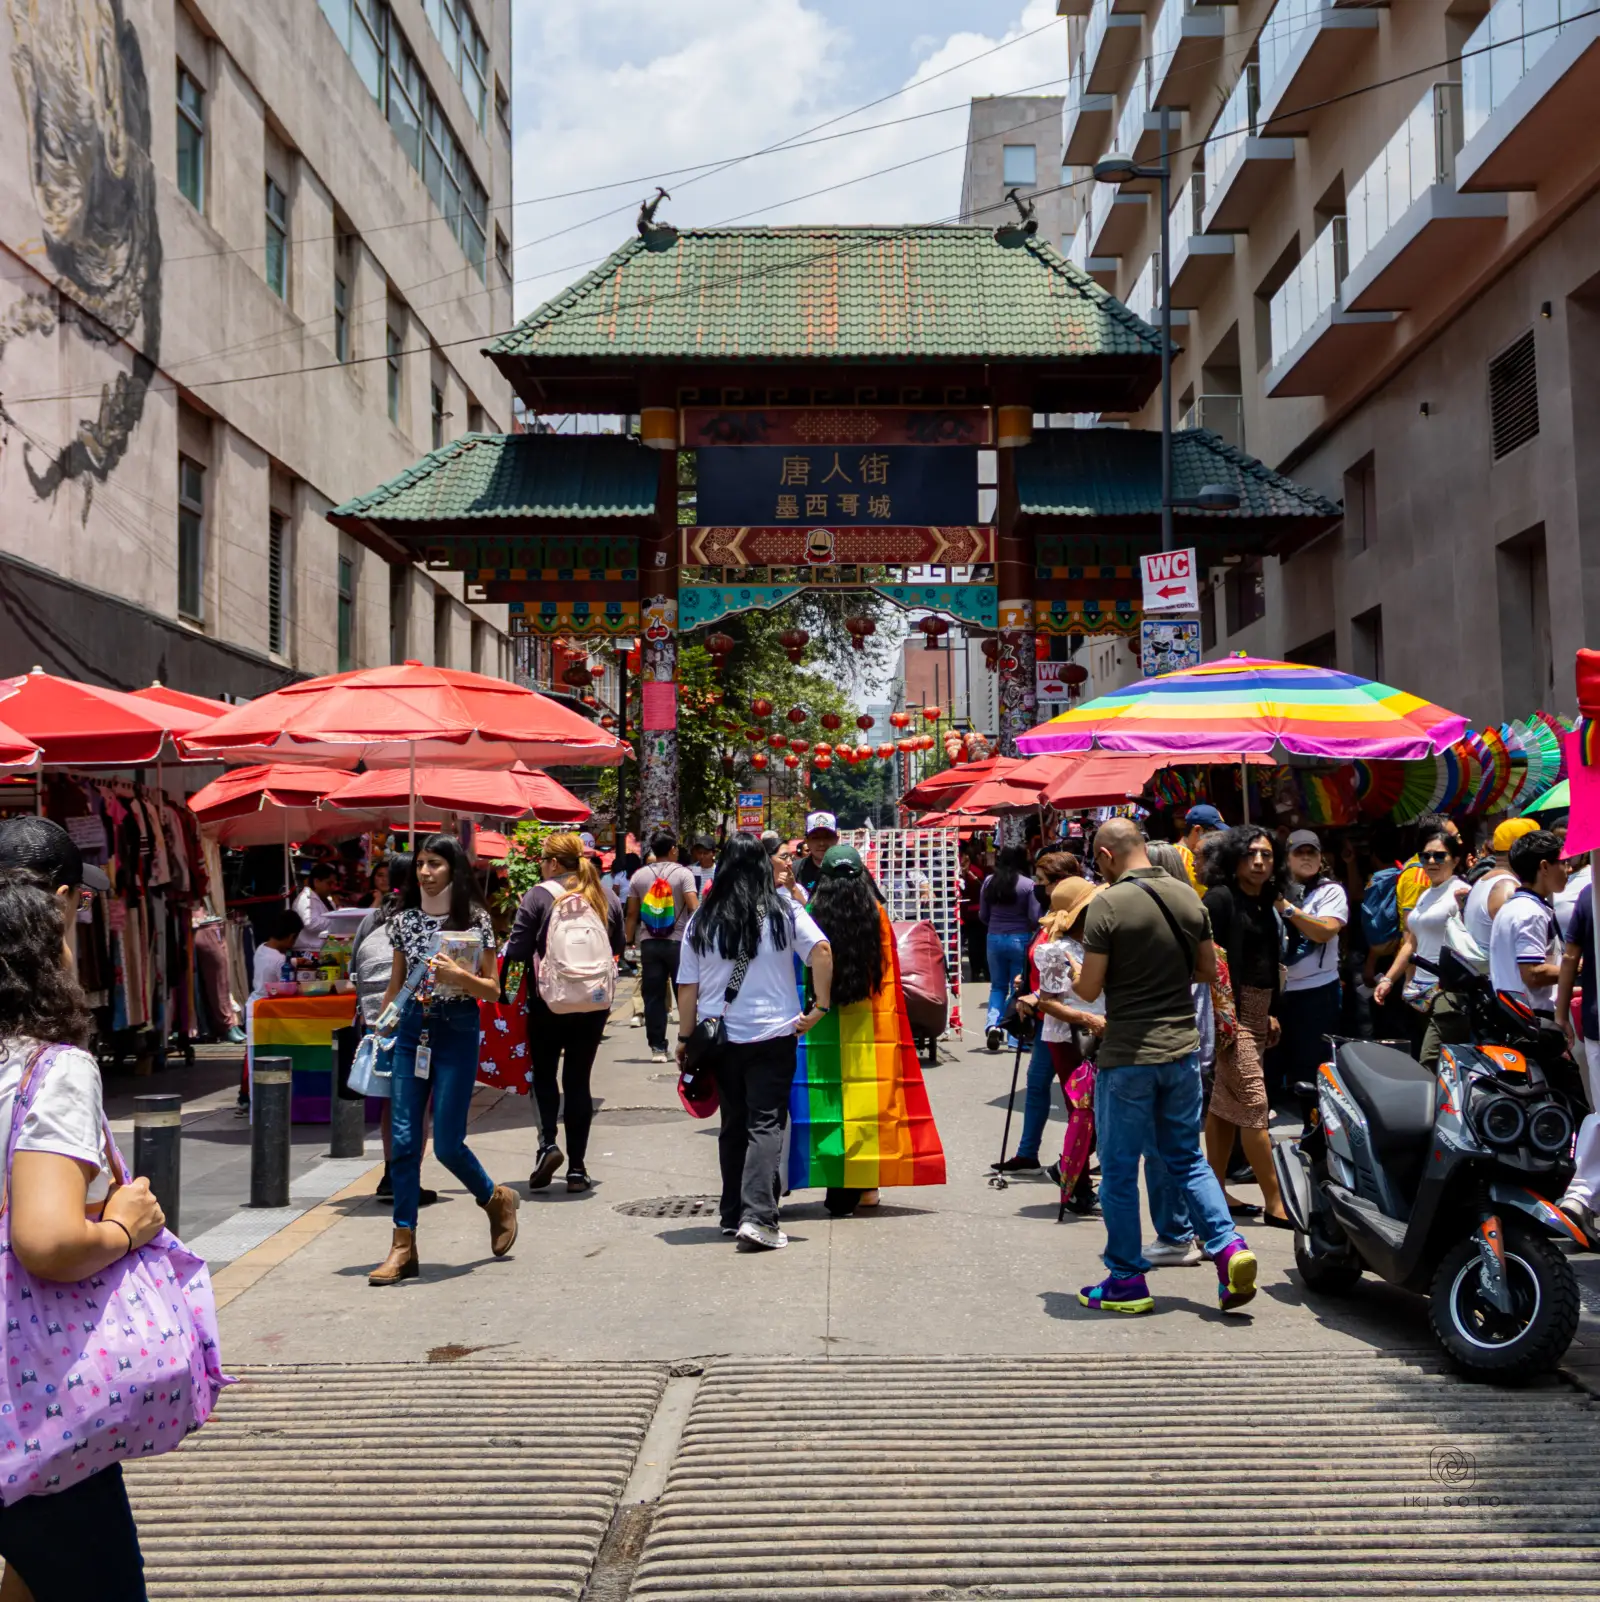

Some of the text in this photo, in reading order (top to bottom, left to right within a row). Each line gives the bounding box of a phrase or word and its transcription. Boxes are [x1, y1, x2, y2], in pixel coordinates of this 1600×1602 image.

[780, 451, 890, 486] 唐人街
[775, 494, 891, 519] 墨西哥城
[1148, 553, 1189, 581] WC
